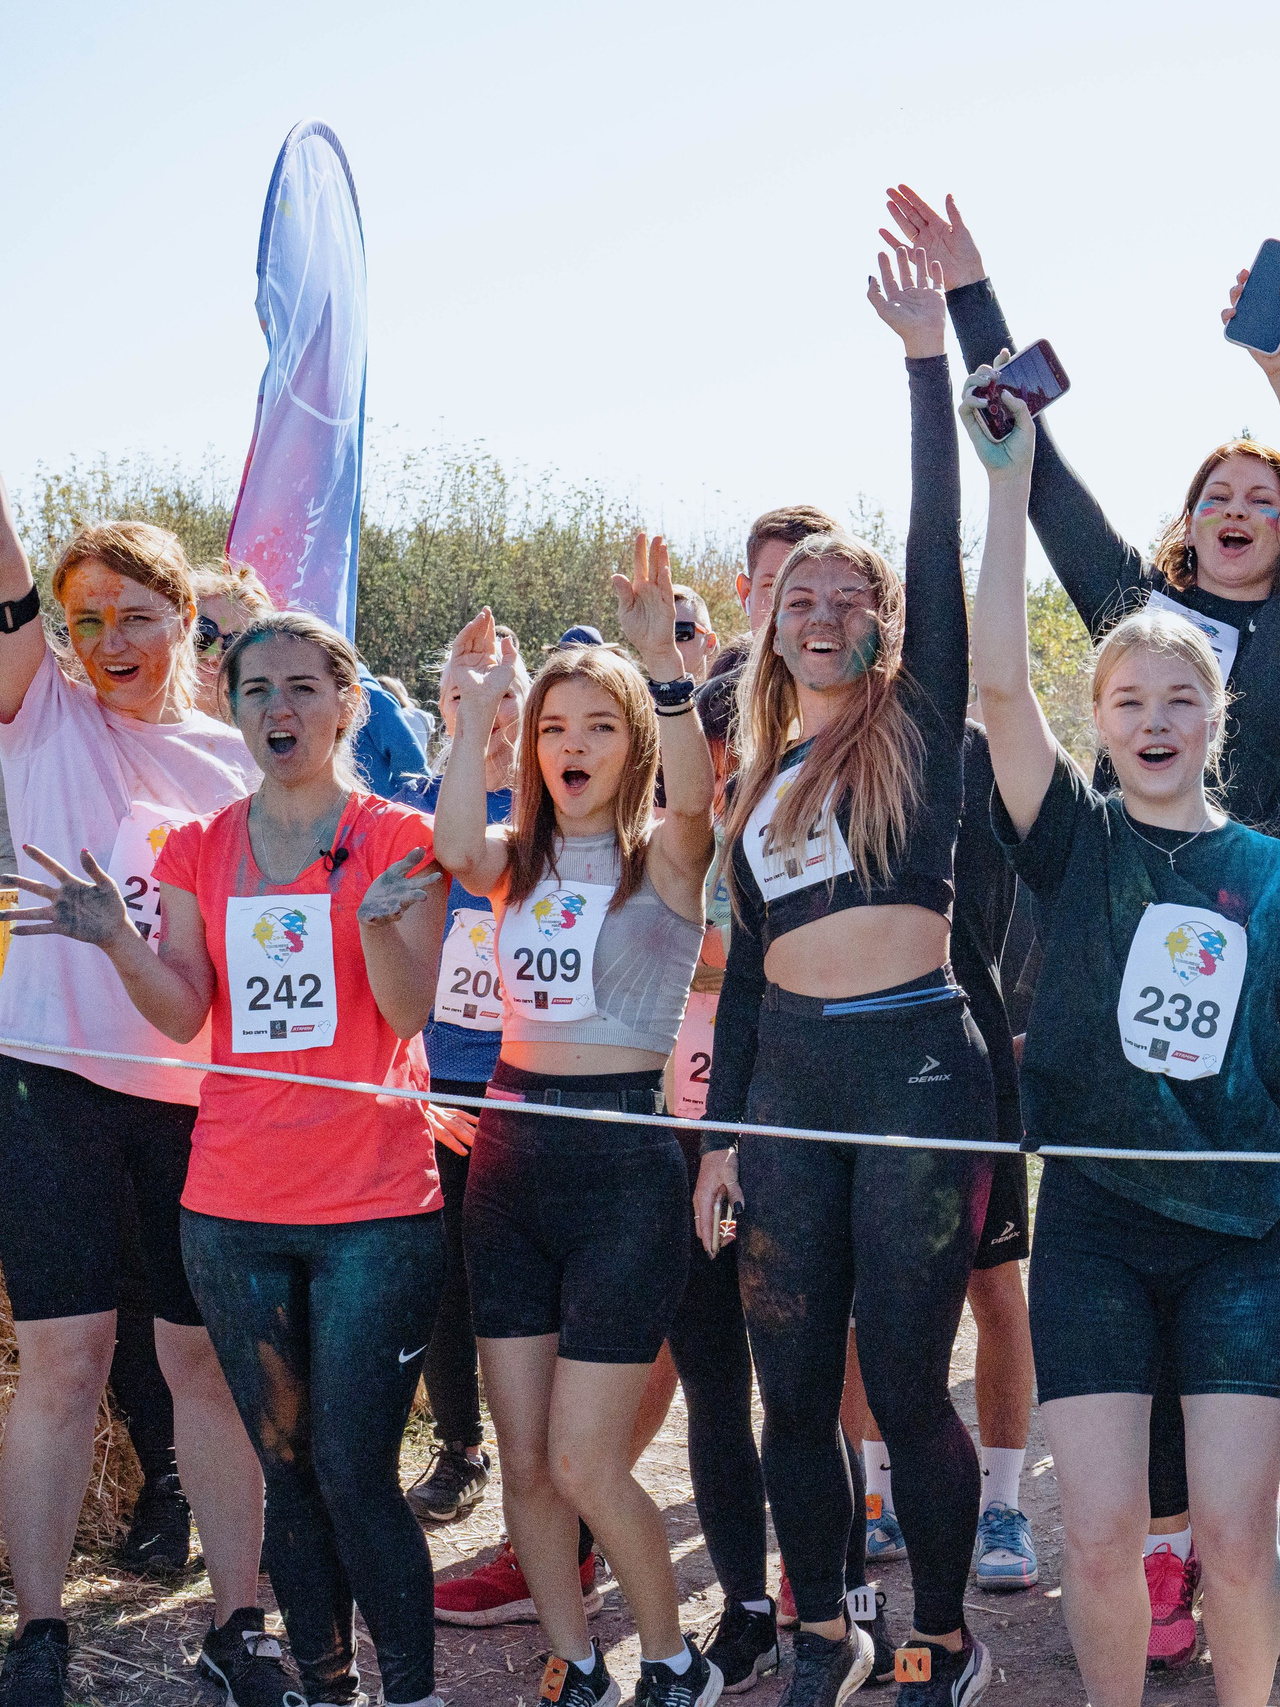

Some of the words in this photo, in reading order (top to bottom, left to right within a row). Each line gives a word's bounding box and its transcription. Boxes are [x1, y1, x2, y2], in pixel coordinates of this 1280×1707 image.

[513, 947, 582, 983] 209
[246, 973, 323, 1011] 242
[1133, 986, 1221, 1039] 238
[908, 1073, 952, 1084] DEMIX
[991, 1230, 1020, 1245] DEMIX
